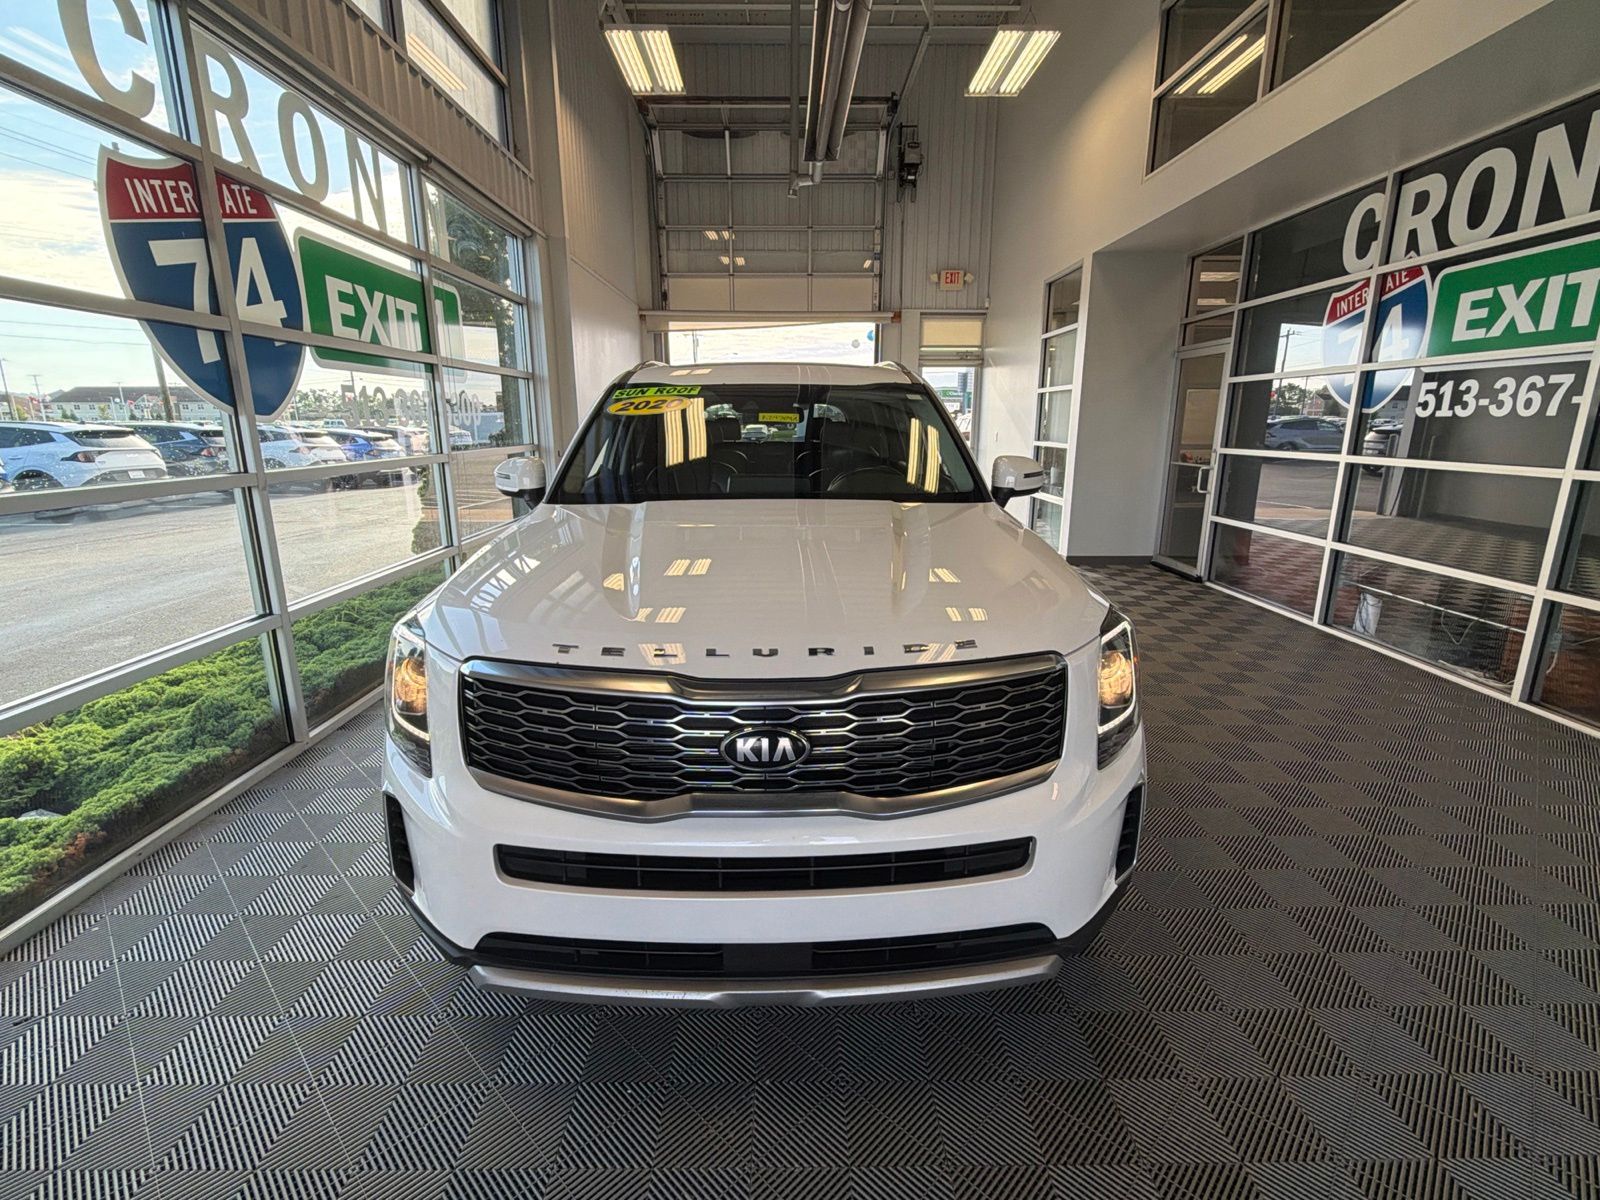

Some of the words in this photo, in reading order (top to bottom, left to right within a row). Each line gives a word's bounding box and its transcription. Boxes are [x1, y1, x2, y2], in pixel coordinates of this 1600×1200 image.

[124, 178, 258, 215] INTERATE
[1343, 110, 1600, 274] CRON
[944, 271, 961, 285] EXIT
[1336, 269, 1410, 317] INTERATE
[148, 237, 287, 364] 74
[324, 275, 423, 353] EXIT
[1452, 267, 1600, 342] EXIT
[1338, 303, 1410, 387] 74
[615, 388, 650, 398] SUN
[654, 386, 698, 395] ROOF
[615, 399, 683, 413] 2020
[552, 639, 979, 658] TELLURIDE
[736, 737, 796, 763] KIA
